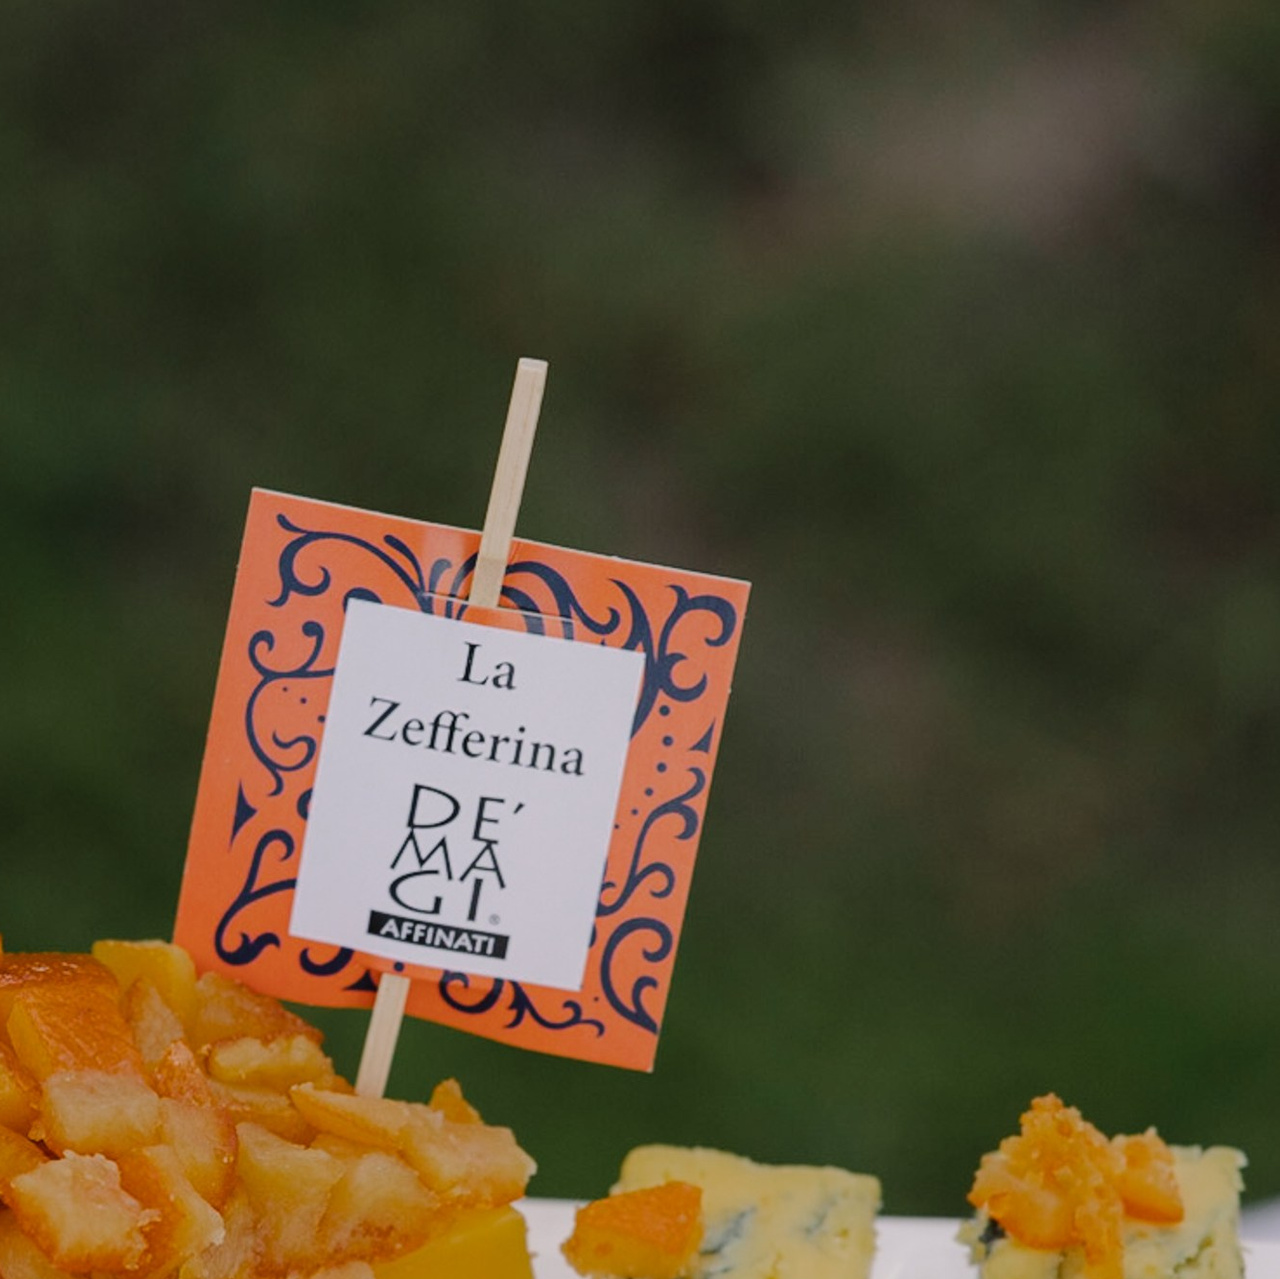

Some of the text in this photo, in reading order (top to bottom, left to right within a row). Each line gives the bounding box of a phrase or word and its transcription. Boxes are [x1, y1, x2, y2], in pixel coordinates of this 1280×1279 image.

[457, 641, 517, 690] La
[362, 696, 585, 777] Zefferina
[379, 918, 496, 955] AFFINATI
